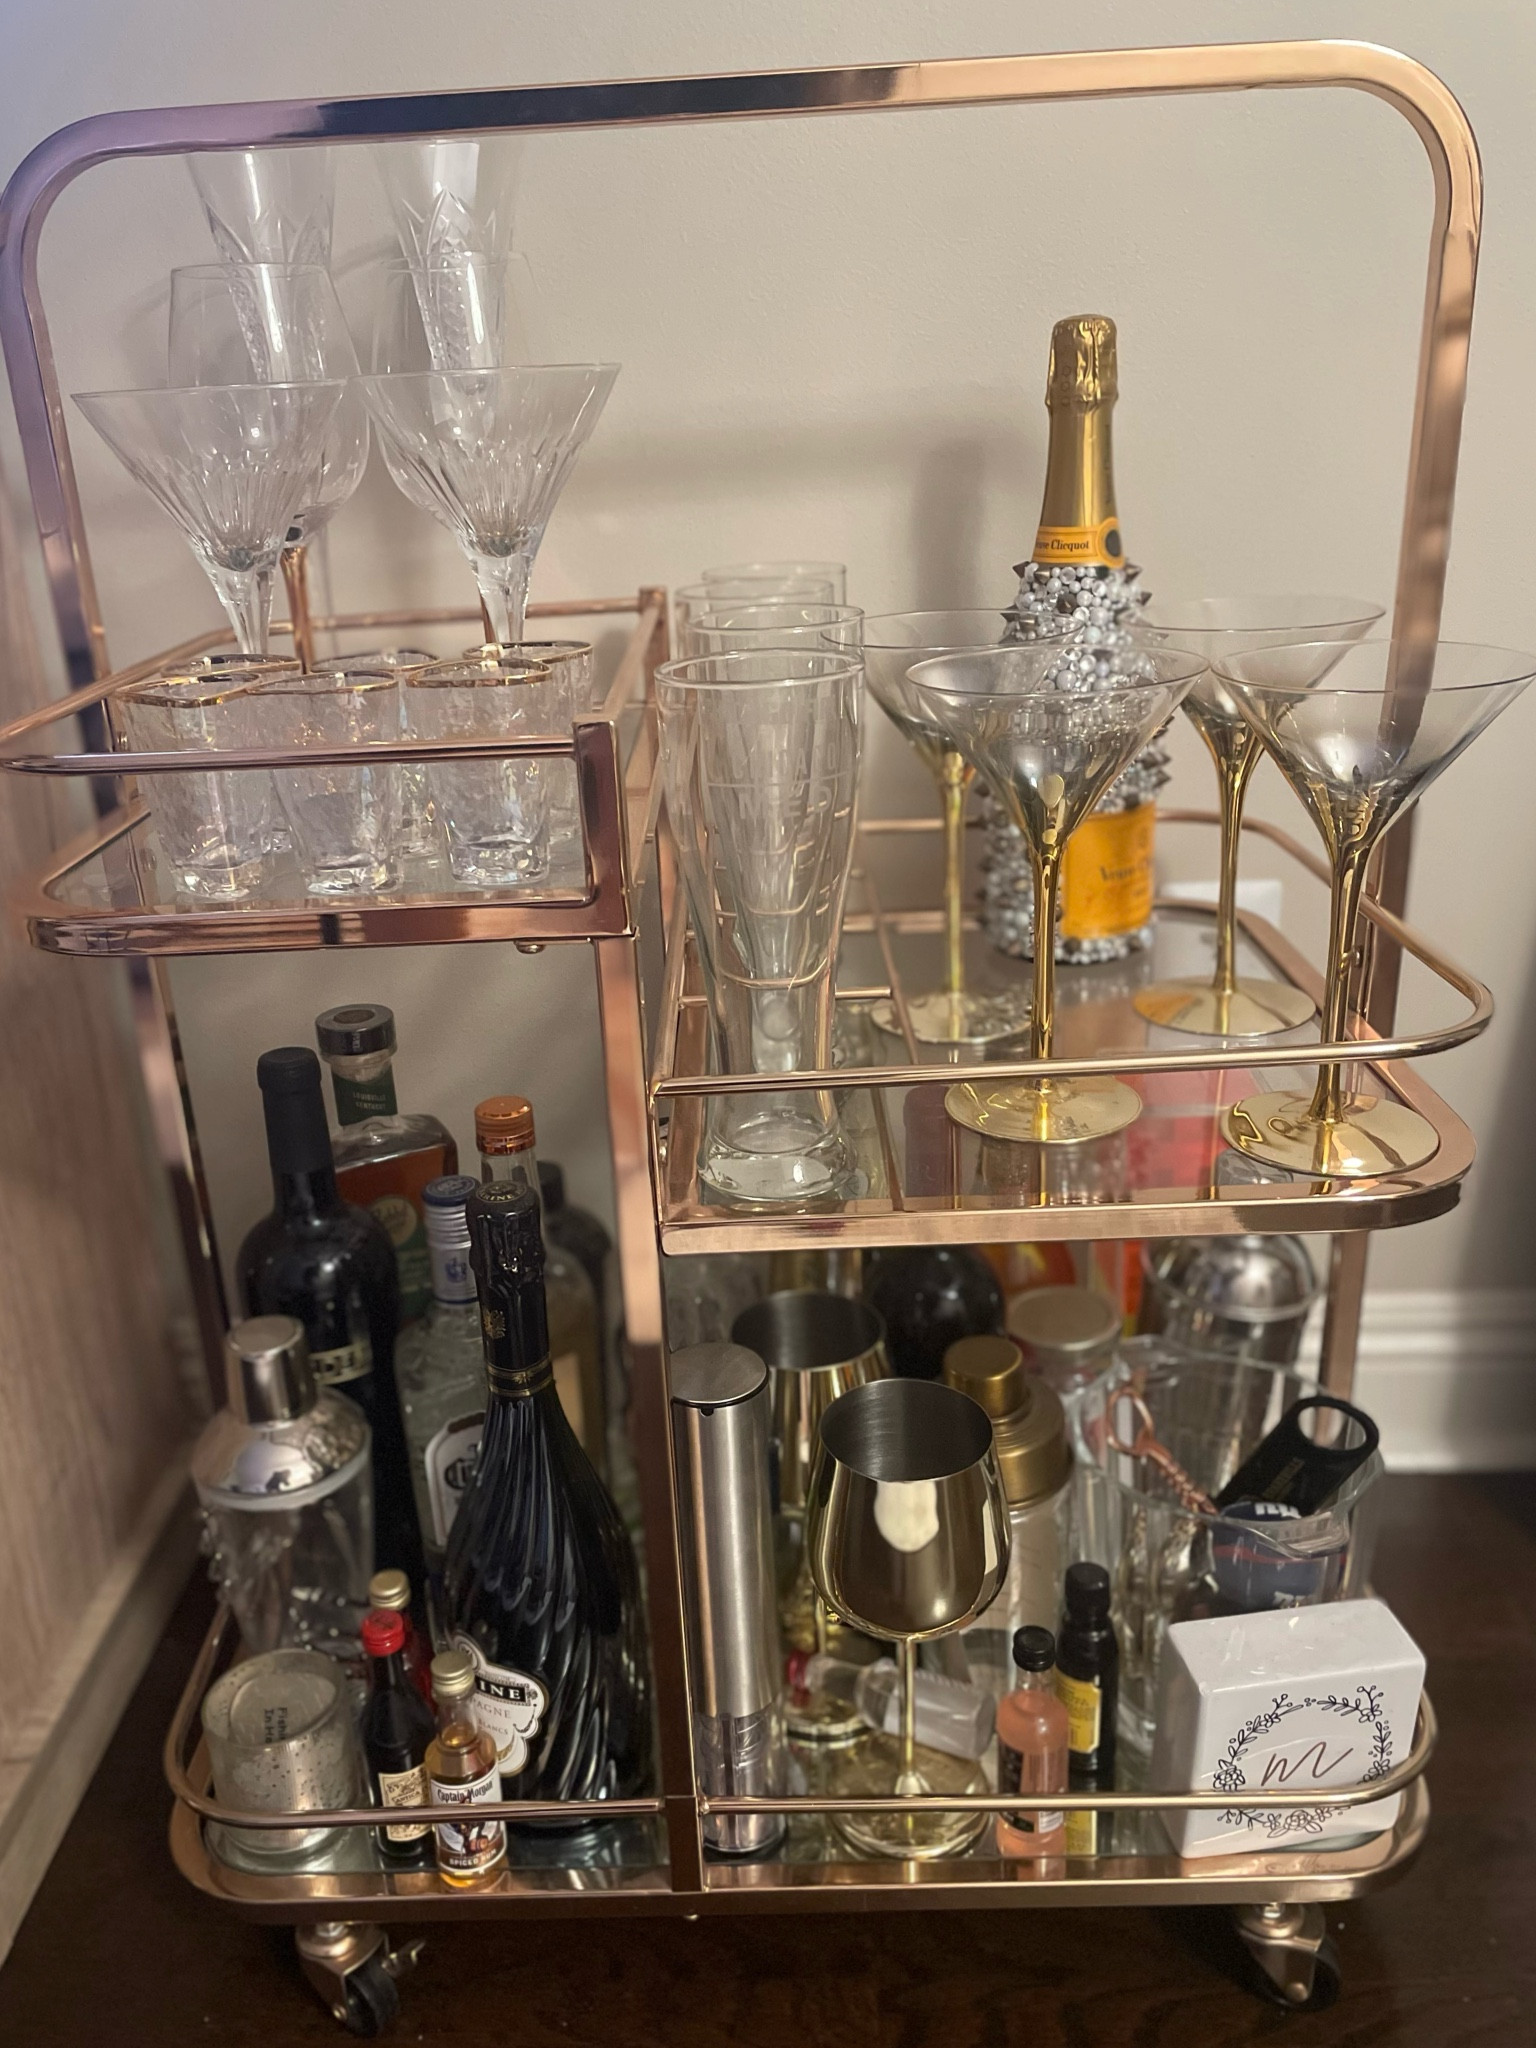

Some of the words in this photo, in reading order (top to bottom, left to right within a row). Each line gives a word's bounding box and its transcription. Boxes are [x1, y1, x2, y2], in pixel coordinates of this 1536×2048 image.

[1051, 538, 1090, 553] Clicquot
[480, 1680, 521, 1700] INE
[437, 1788, 465, 1803] Captain
[466, 1781, 493, 1804] Morgan
